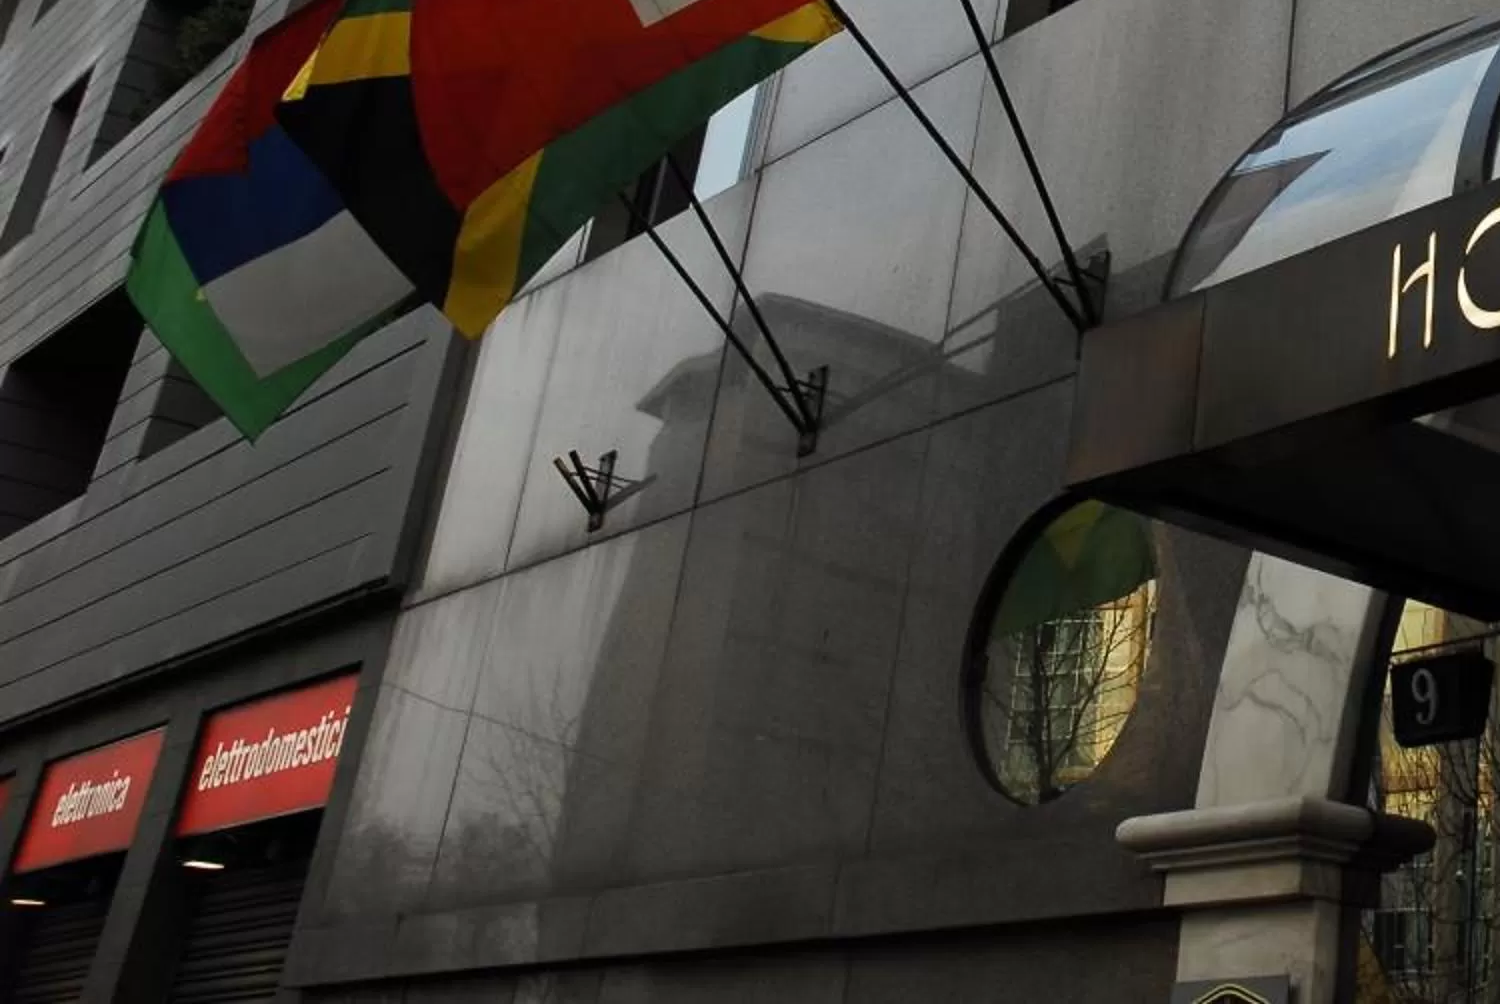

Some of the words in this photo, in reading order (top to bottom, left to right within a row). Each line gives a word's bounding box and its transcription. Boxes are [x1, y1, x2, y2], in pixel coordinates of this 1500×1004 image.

[1411, 668, 1438, 725] 9
[198, 707, 352, 791] elettrodomestici
[52, 770, 131, 827] elettronica
